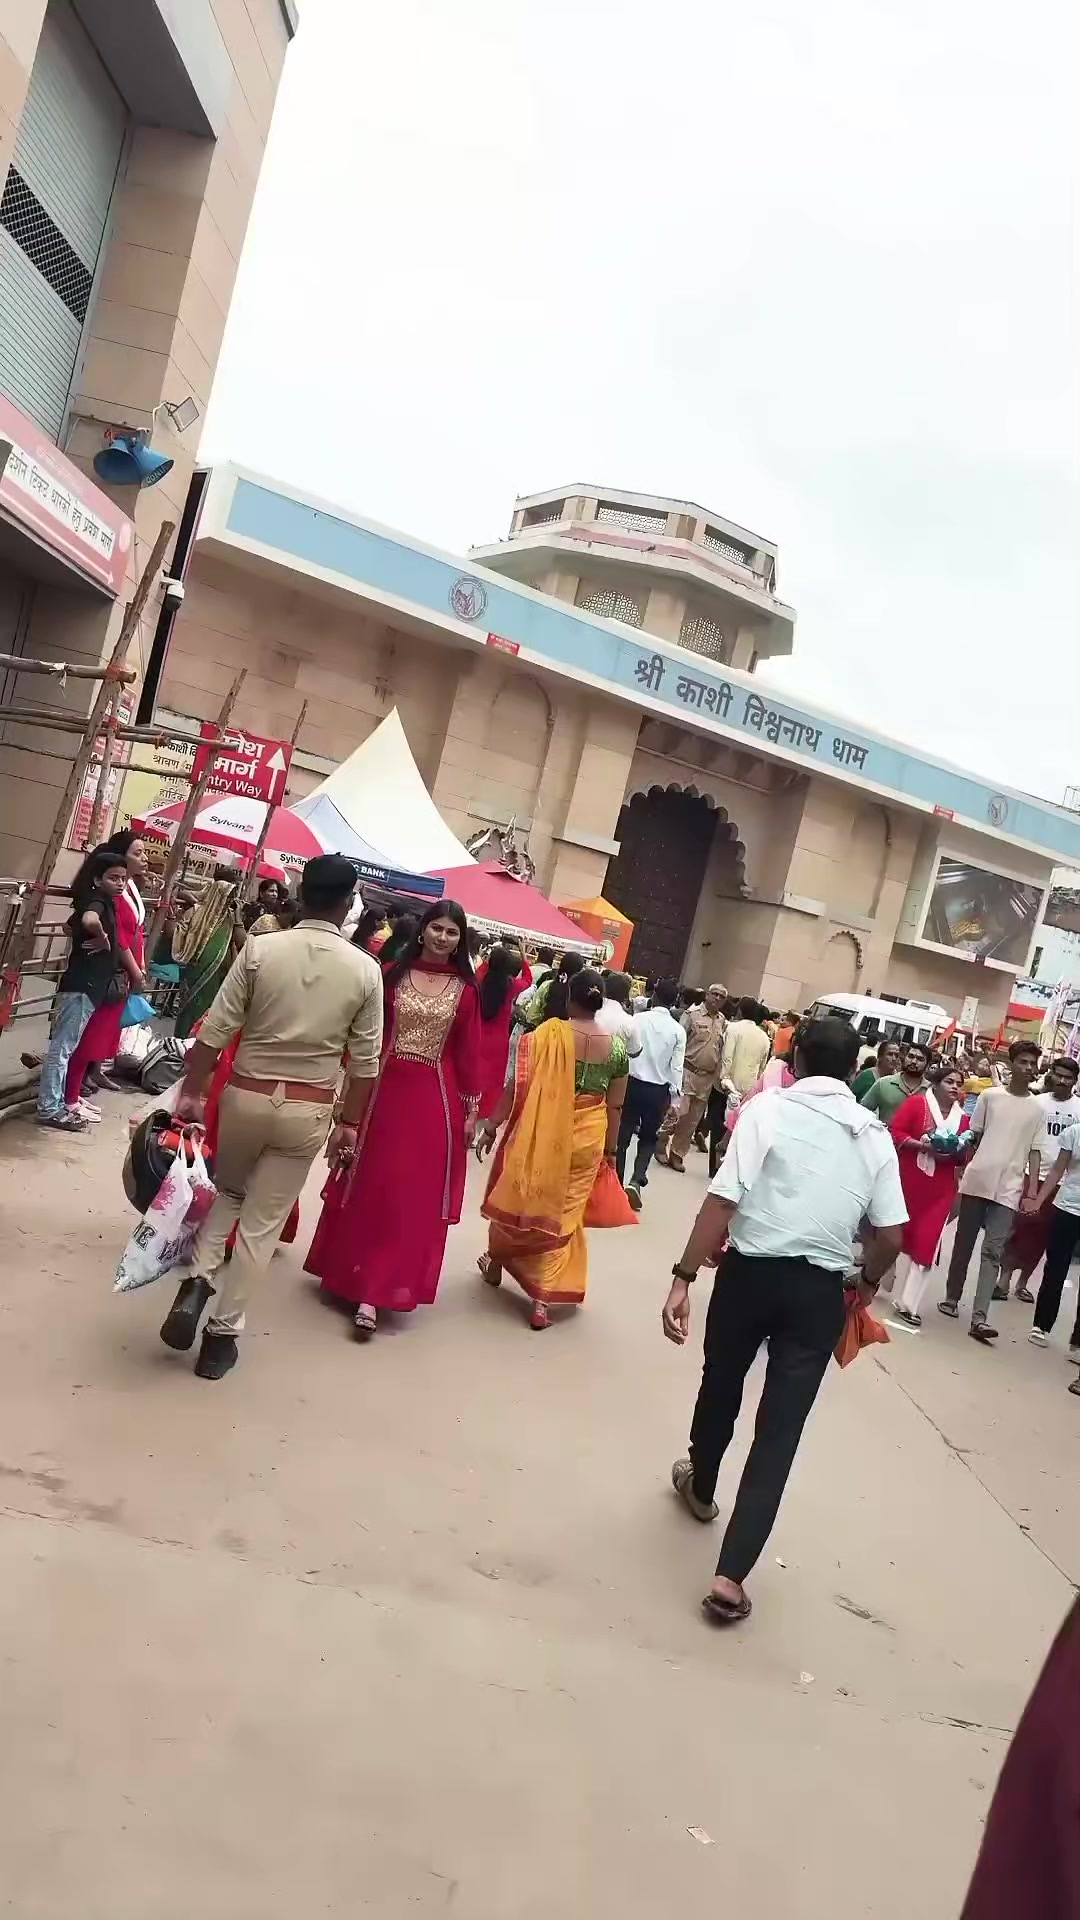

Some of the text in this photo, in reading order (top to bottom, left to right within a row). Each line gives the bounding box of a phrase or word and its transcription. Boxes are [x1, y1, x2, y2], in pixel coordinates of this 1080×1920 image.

[30, 465, 49, 498] टिकट
[634, 654, 870, 770] श्री काशी विश्वनाथ धाम
[214, 756, 260, 780] मार्ग
[235, 779, 262, 798] Way
[210, 815, 245, 832] Sylvan
[361, 866, 386, 879] BANK
